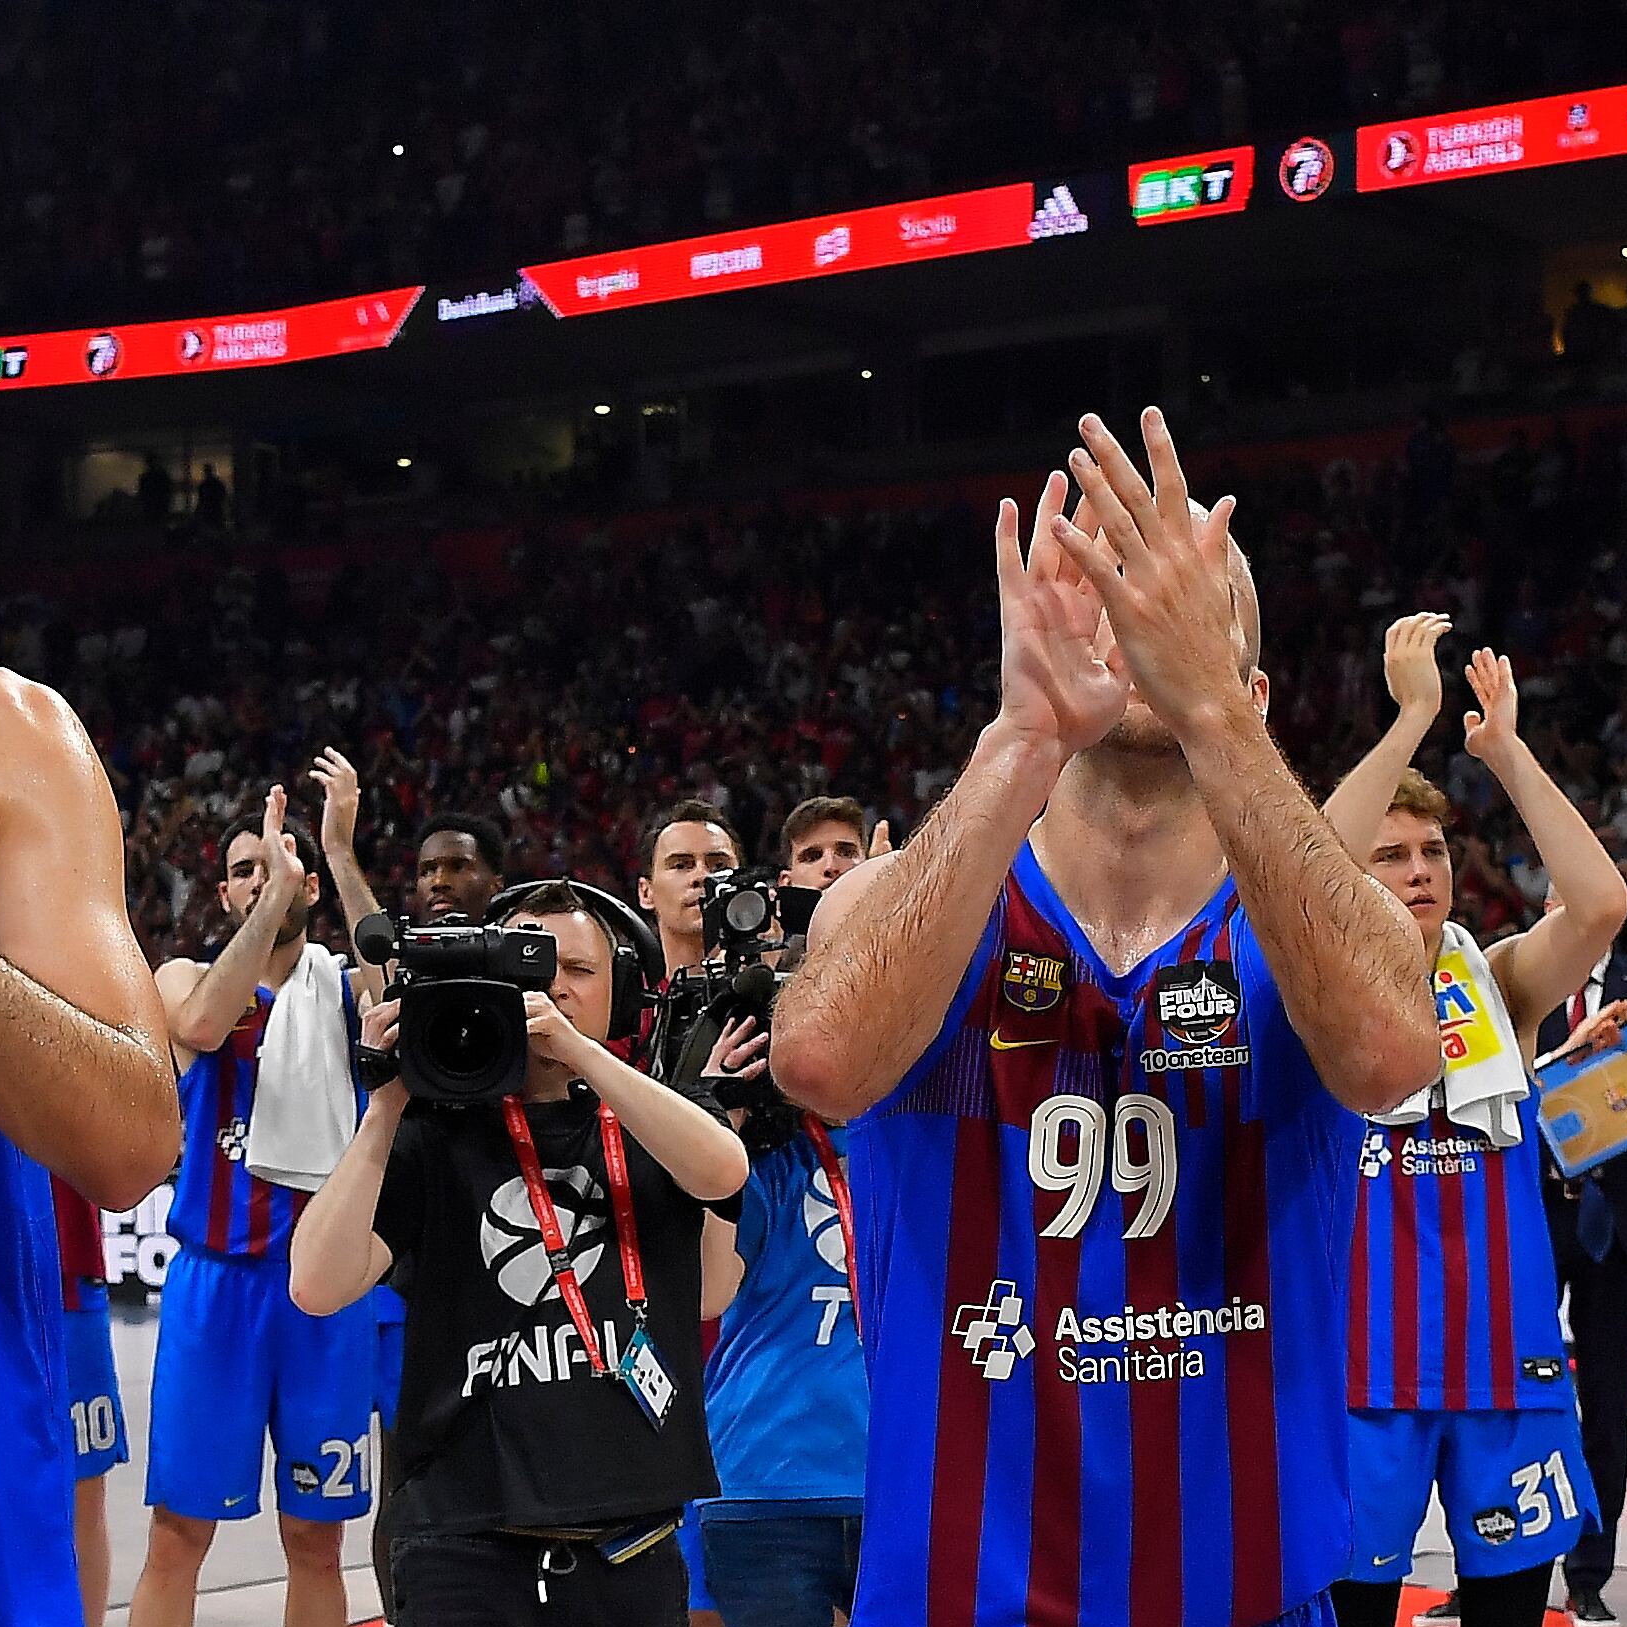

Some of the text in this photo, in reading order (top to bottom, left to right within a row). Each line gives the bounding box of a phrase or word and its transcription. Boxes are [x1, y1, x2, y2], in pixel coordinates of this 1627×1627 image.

[1426, 115, 1524, 152] TURKISH
[1424, 142, 1525, 175] AIRLINES
[212, 318, 288, 343] TURKISH
[211, 339, 288, 362] AIRLINES
[1159, 976, 1228, 1006] FINAL
[1160, 999, 1236, 1021] FOUR
[1028, 1093, 1178, 1239] 99
[1054, 1296, 1265, 1344] Assistència
[1058, 1342, 1205, 1383] Sanitària
[69, 1395, 116, 1456] 10
[319, 1433, 371, 1498] 21
[1511, 1449, 1580, 1538] 31
